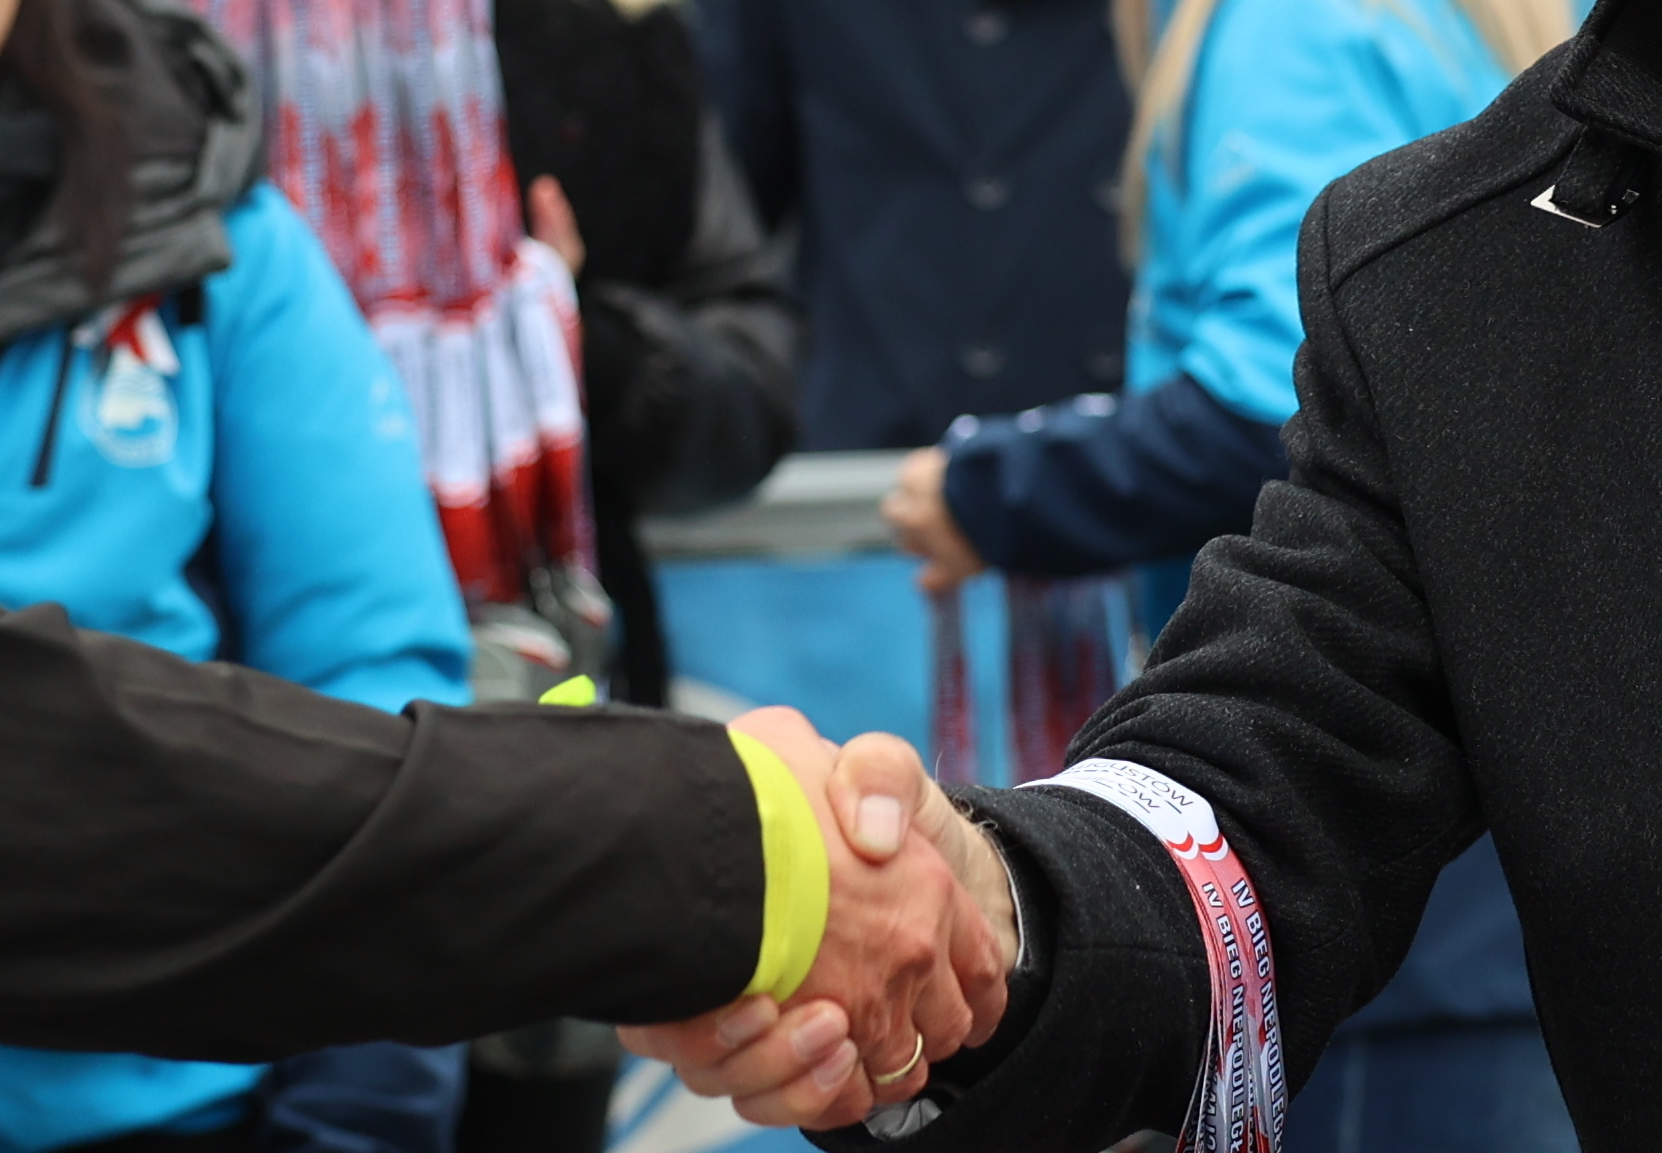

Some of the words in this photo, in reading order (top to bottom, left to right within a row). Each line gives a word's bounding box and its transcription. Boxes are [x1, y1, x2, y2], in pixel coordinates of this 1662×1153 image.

[1202, 881, 1224, 908] IV
[1216, 913, 1242, 981] BIEG
[1230, 877, 1256, 908] IV
[1245, 909, 1271, 981] BIEG
